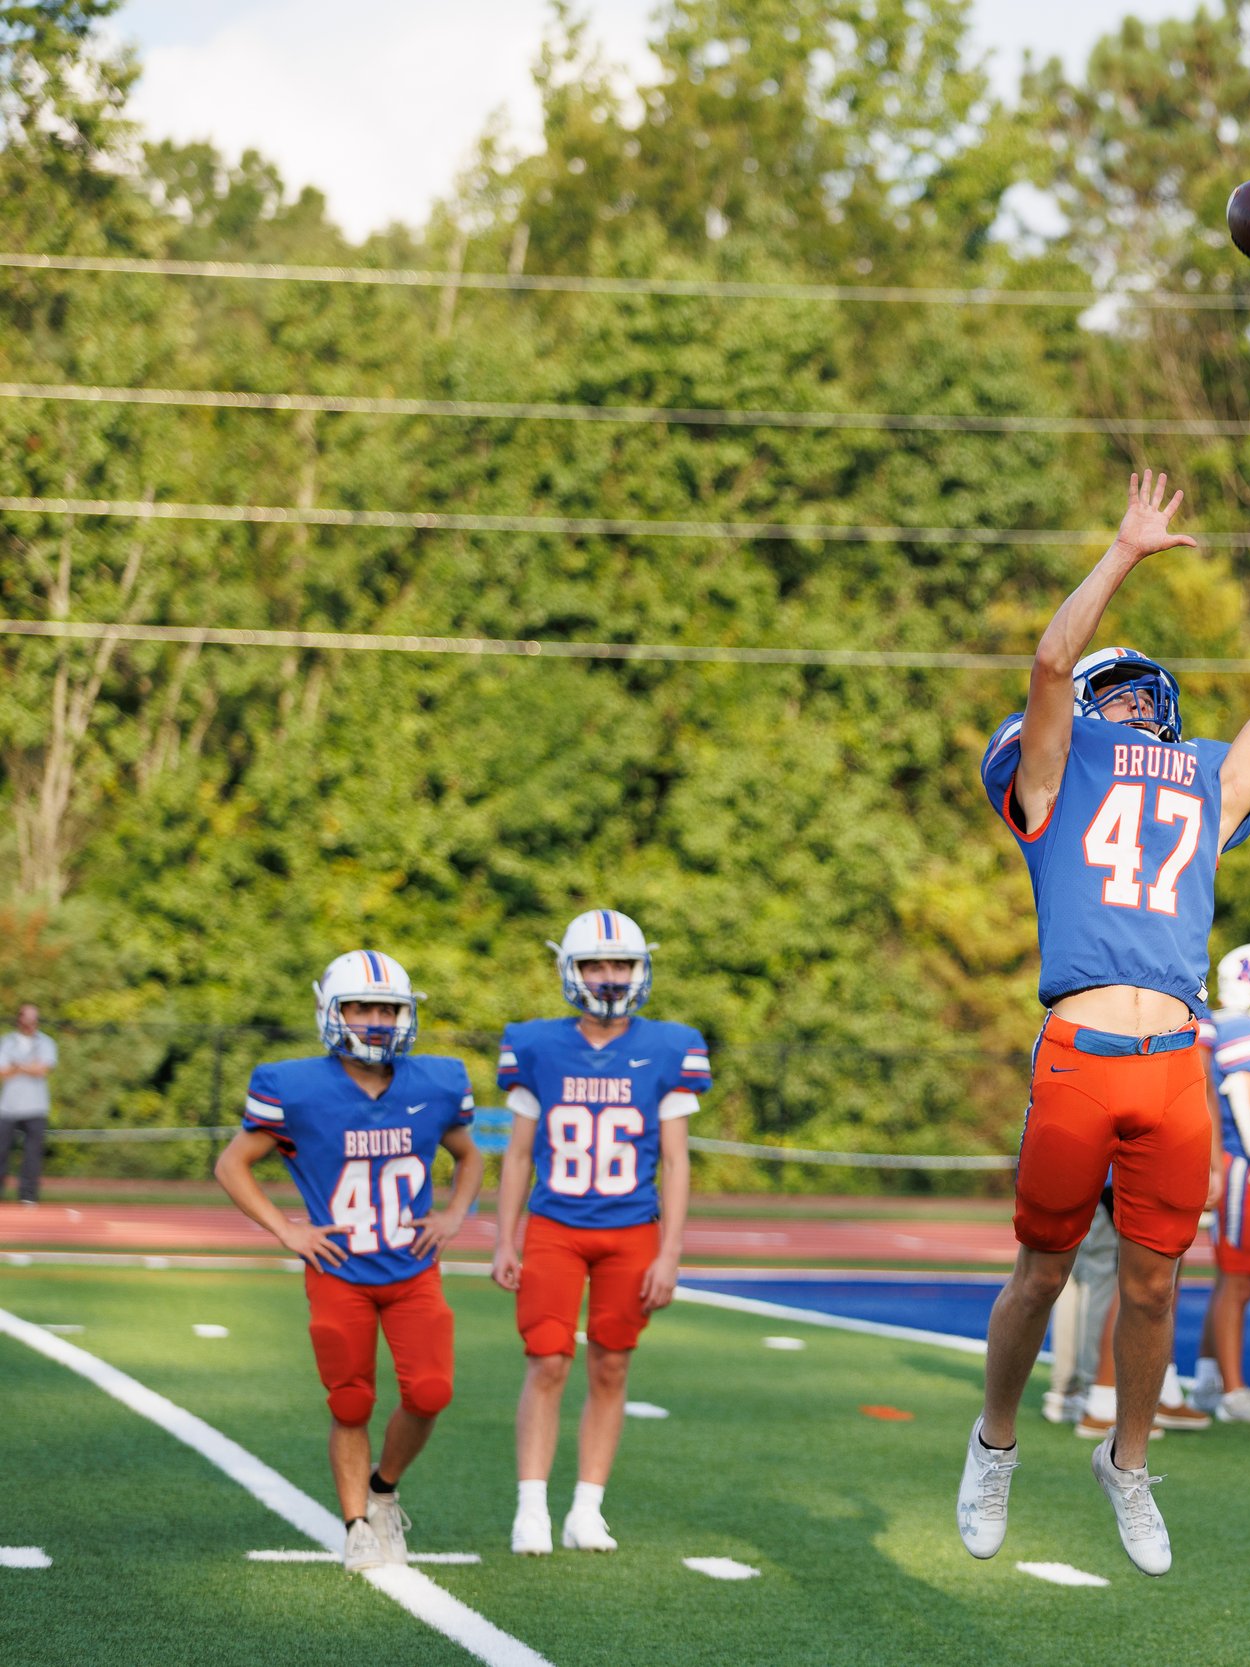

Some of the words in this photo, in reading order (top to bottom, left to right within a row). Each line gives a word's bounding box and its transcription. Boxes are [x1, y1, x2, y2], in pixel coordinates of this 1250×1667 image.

[1113, 744, 1197, 786] BRUINS
[1082, 782, 1204, 916] 47
[563, 1077, 632, 1104] BRUINS
[345, 1127, 412, 1158] BRUINS
[548, 1105, 644, 1197] 86
[330, 1155, 426, 1255] 40
